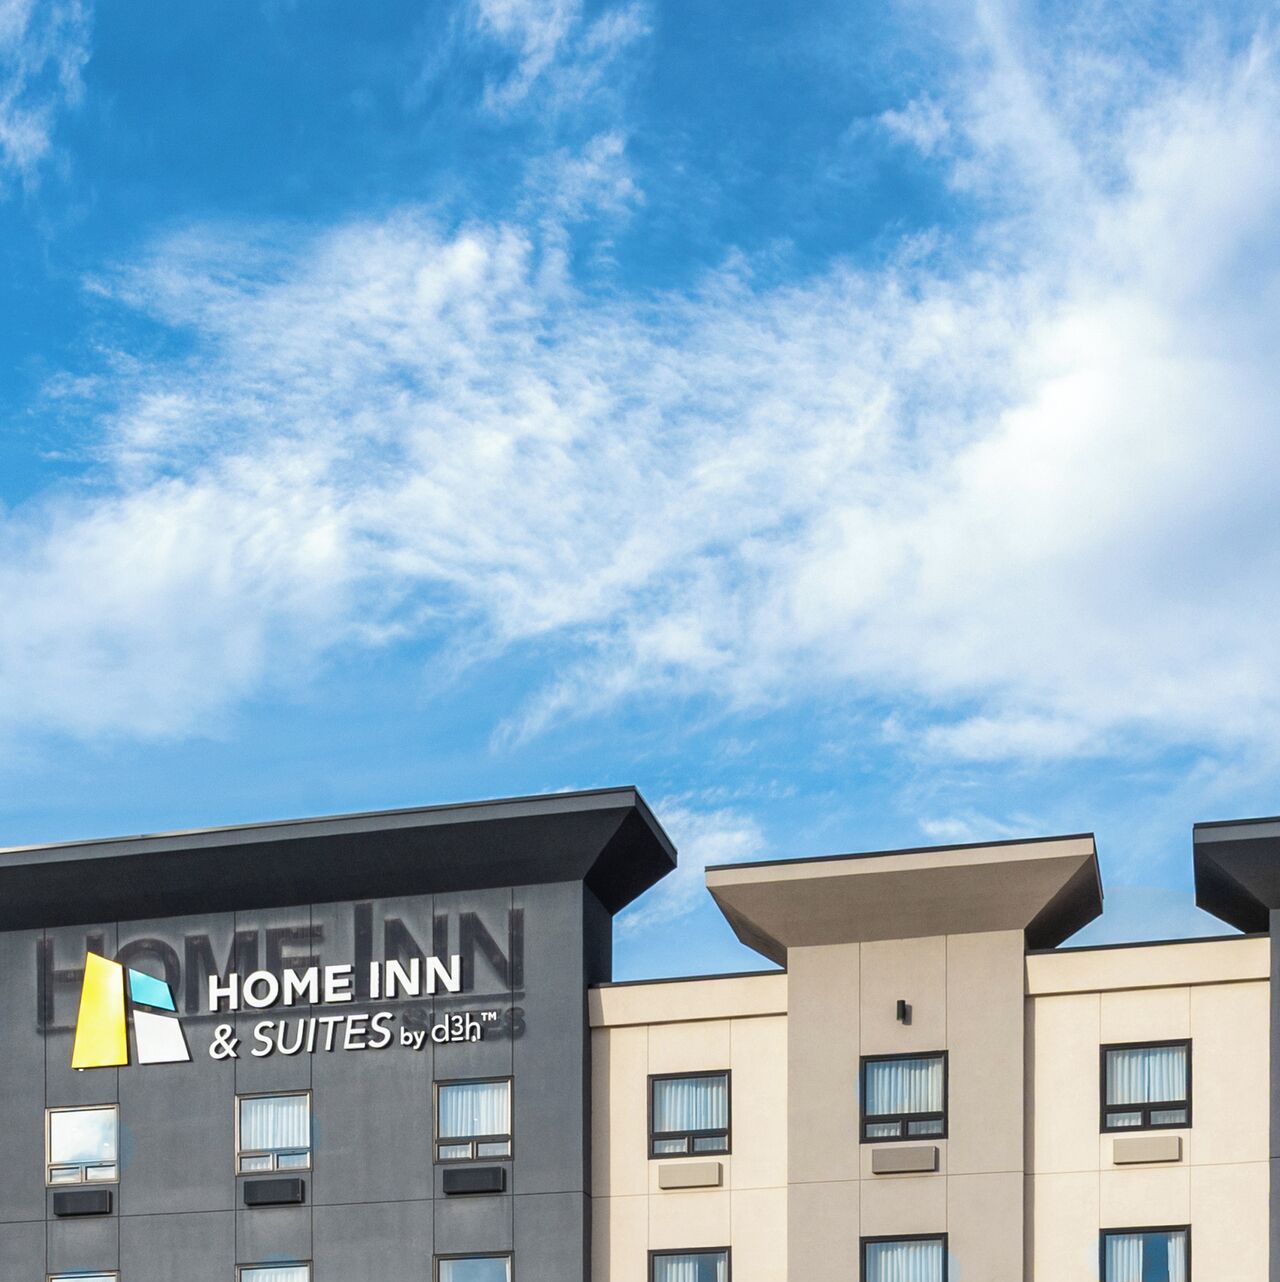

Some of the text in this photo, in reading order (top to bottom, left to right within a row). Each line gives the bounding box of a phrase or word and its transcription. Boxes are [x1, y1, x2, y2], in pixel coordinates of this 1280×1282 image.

[209, 955, 461, 1012] HOME INN
[209, 1024, 239, 1059] &
[251, 1012, 393, 1057] SUITES
[400, 1026, 426, 1050] by
